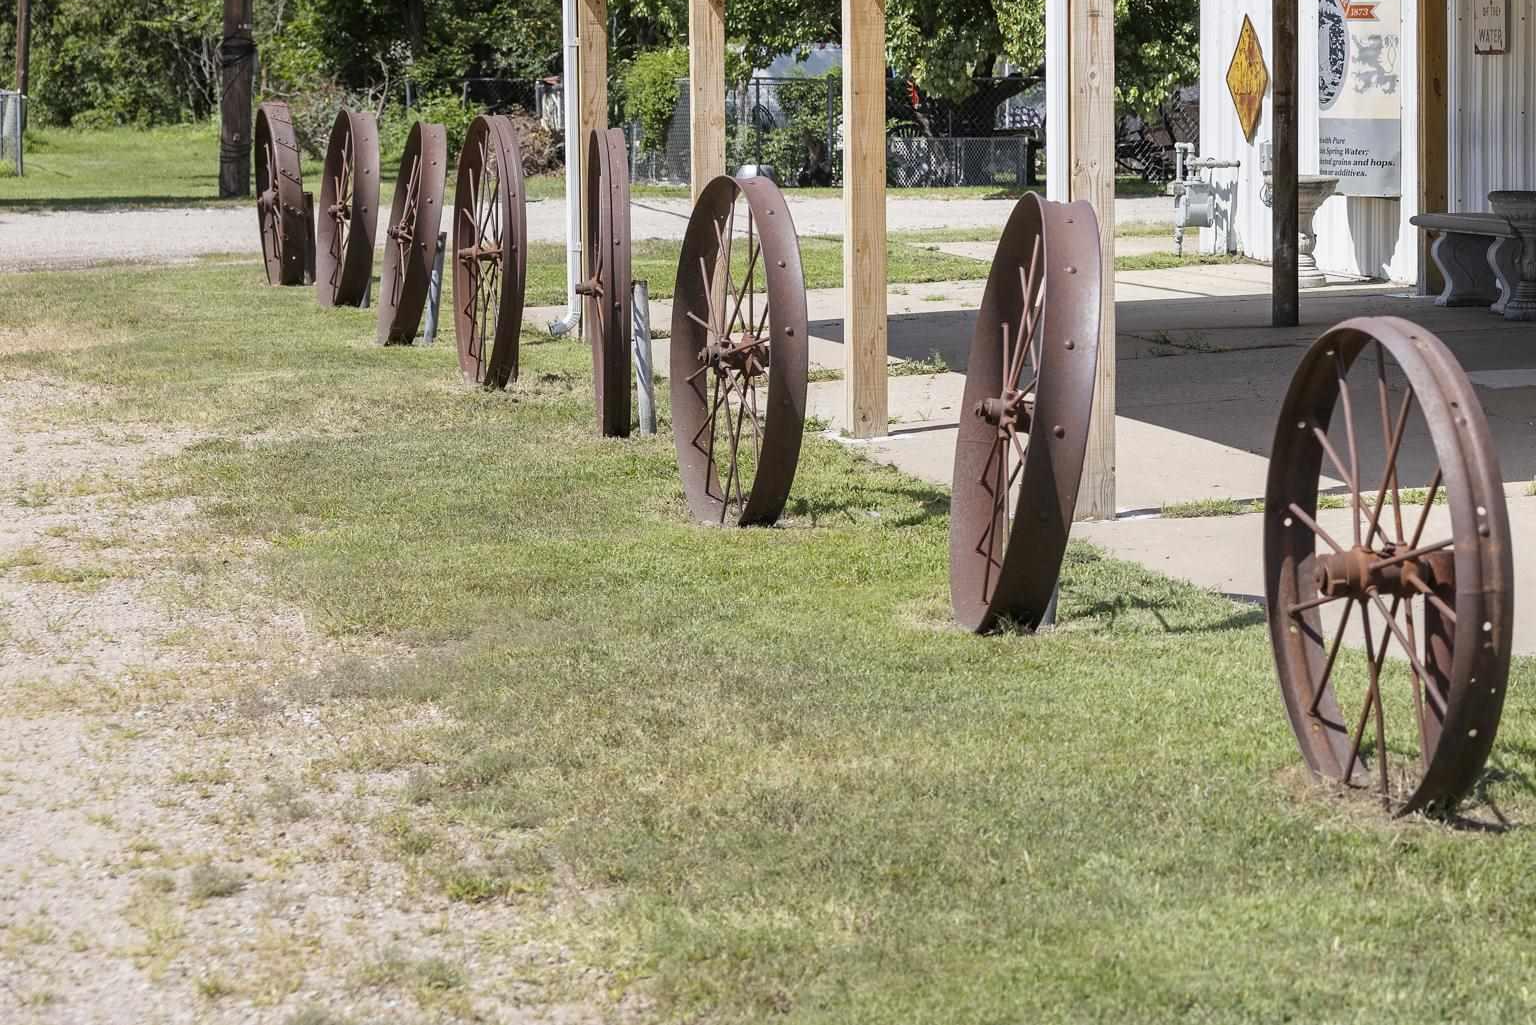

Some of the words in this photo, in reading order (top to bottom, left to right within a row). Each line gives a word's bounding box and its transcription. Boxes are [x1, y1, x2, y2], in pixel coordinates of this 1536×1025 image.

[1351, 7, 1369, 17] 1873
[1478, 29, 1503, 46] WATER
[1352, 158, 1369, 166] and
[1370, 158, 1396, 168] hops.
